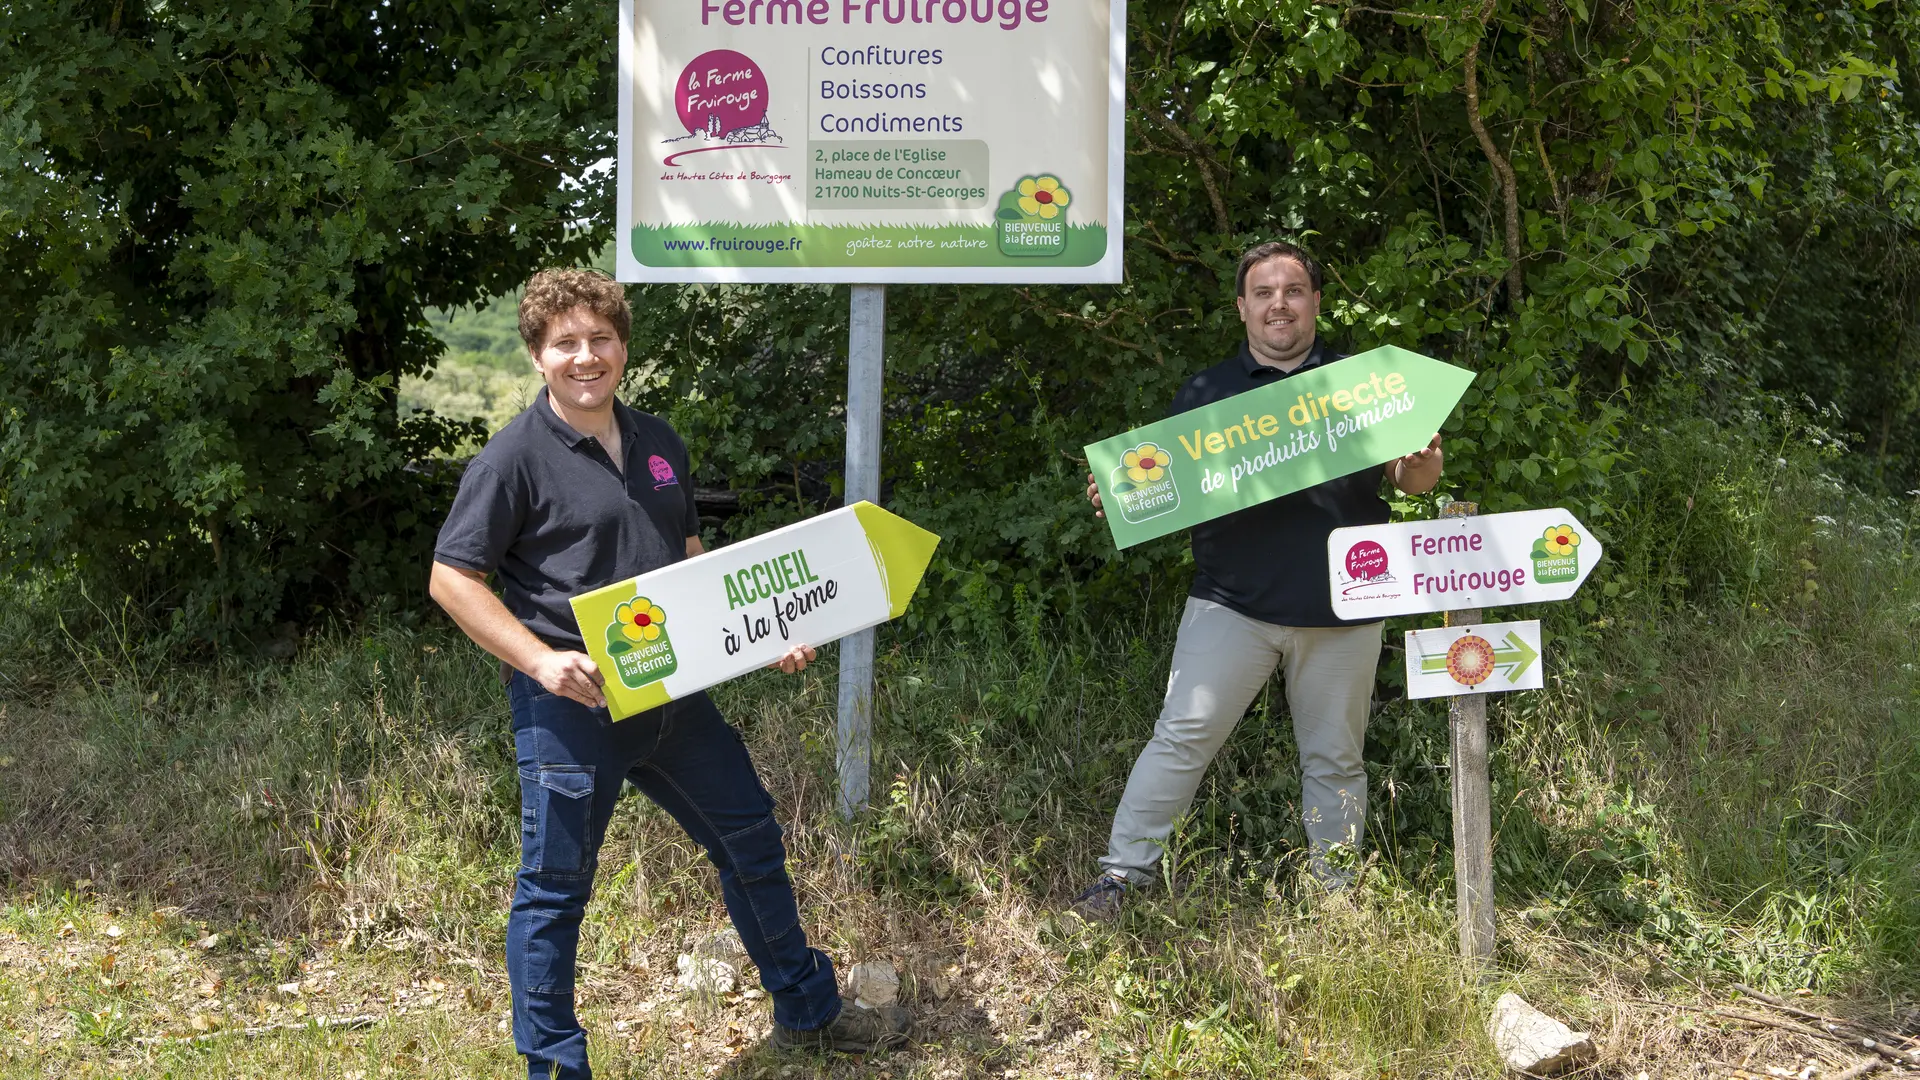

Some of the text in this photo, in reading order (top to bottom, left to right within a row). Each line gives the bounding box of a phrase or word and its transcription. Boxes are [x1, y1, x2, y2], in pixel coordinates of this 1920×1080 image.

[701, 0, 1049, 31] Ferme Fruirouge
[820, 45, 943, 66] Confitures
[688, 68, 752, 91] la Ferme
[820, 79, 927, 100] Boissons
[687, 89, 758, 113] Fruirouge
[820, 112, 963, 133] Condiments
[815, 148, 946, 163] 2, place de l'Eglise
[660, 171, 791, 184] des Hautes Côtes de Bourgogne
[815, 167, 961, 180] Hameau de Concœur
[815, 185, 985, 200] 21700 Nuits-St-Georges
[1004, 222, 1062, 233] BIENVENUE
[663, 237, 803, 254] www.fruirouge.fr
[846, 235, 989, 256] goûtez notre nature
[1005, 232, 1061, 246] à la ferme
[1177, 371, 1407, 461] Vente directe
[1200, 391, 1416, 494] de produits fermiers
[1123, 480, 1172, 504] BIENVENUE
[1126, 491, 1175, 513] à la ferme
[1359, 547, 1381, 559] Ferme
[1410, 533, 1483, 557] Ferme
[1351, 556, 1384, 571] Fruirouge
[1536, 557, 1576, 568] BIENVENUE
[1537, 566, 1576, 577] à la ferme
[723, 549, 818, 610] ACCUEIL
[1413, 568, 1526, 595] Fruirouge
[722, 578, 839, 656] à la ferme
[619, 640, 670, 666] BIENVENUE
[624, 653, 673, 677] à la ferme
